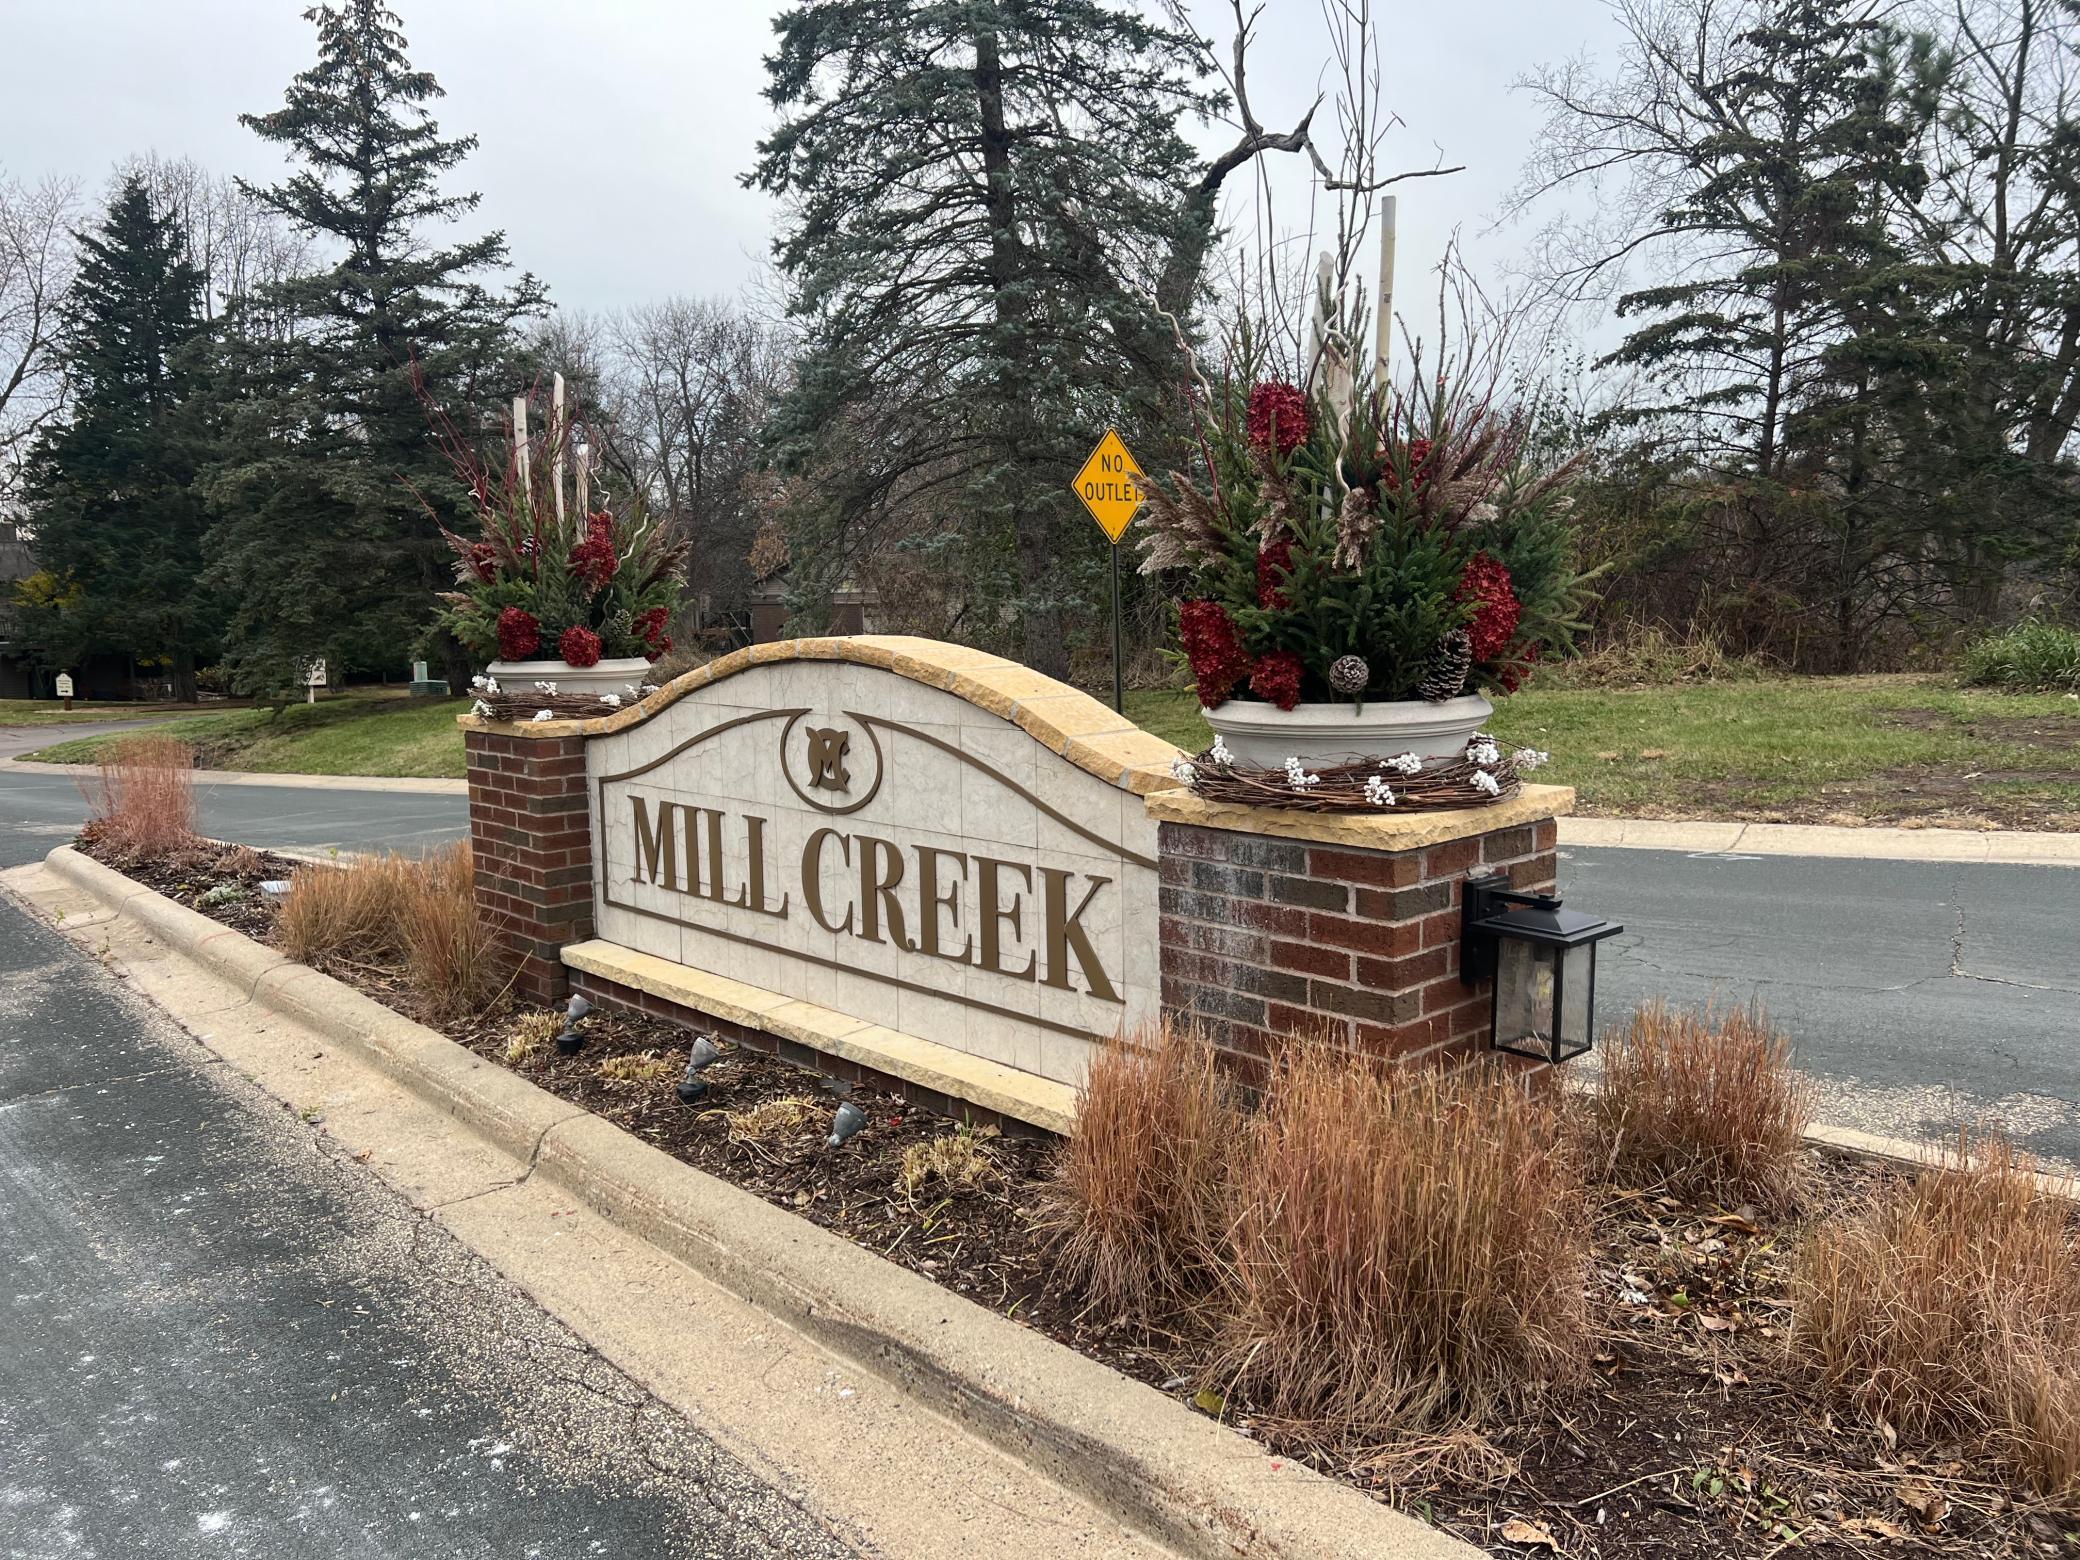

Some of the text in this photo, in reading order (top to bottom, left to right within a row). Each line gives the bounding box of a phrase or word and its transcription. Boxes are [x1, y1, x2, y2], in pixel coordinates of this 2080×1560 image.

[1101, 454, 1123, 473] NO
[627, 795, 1126, 1004] MILL CREEK
